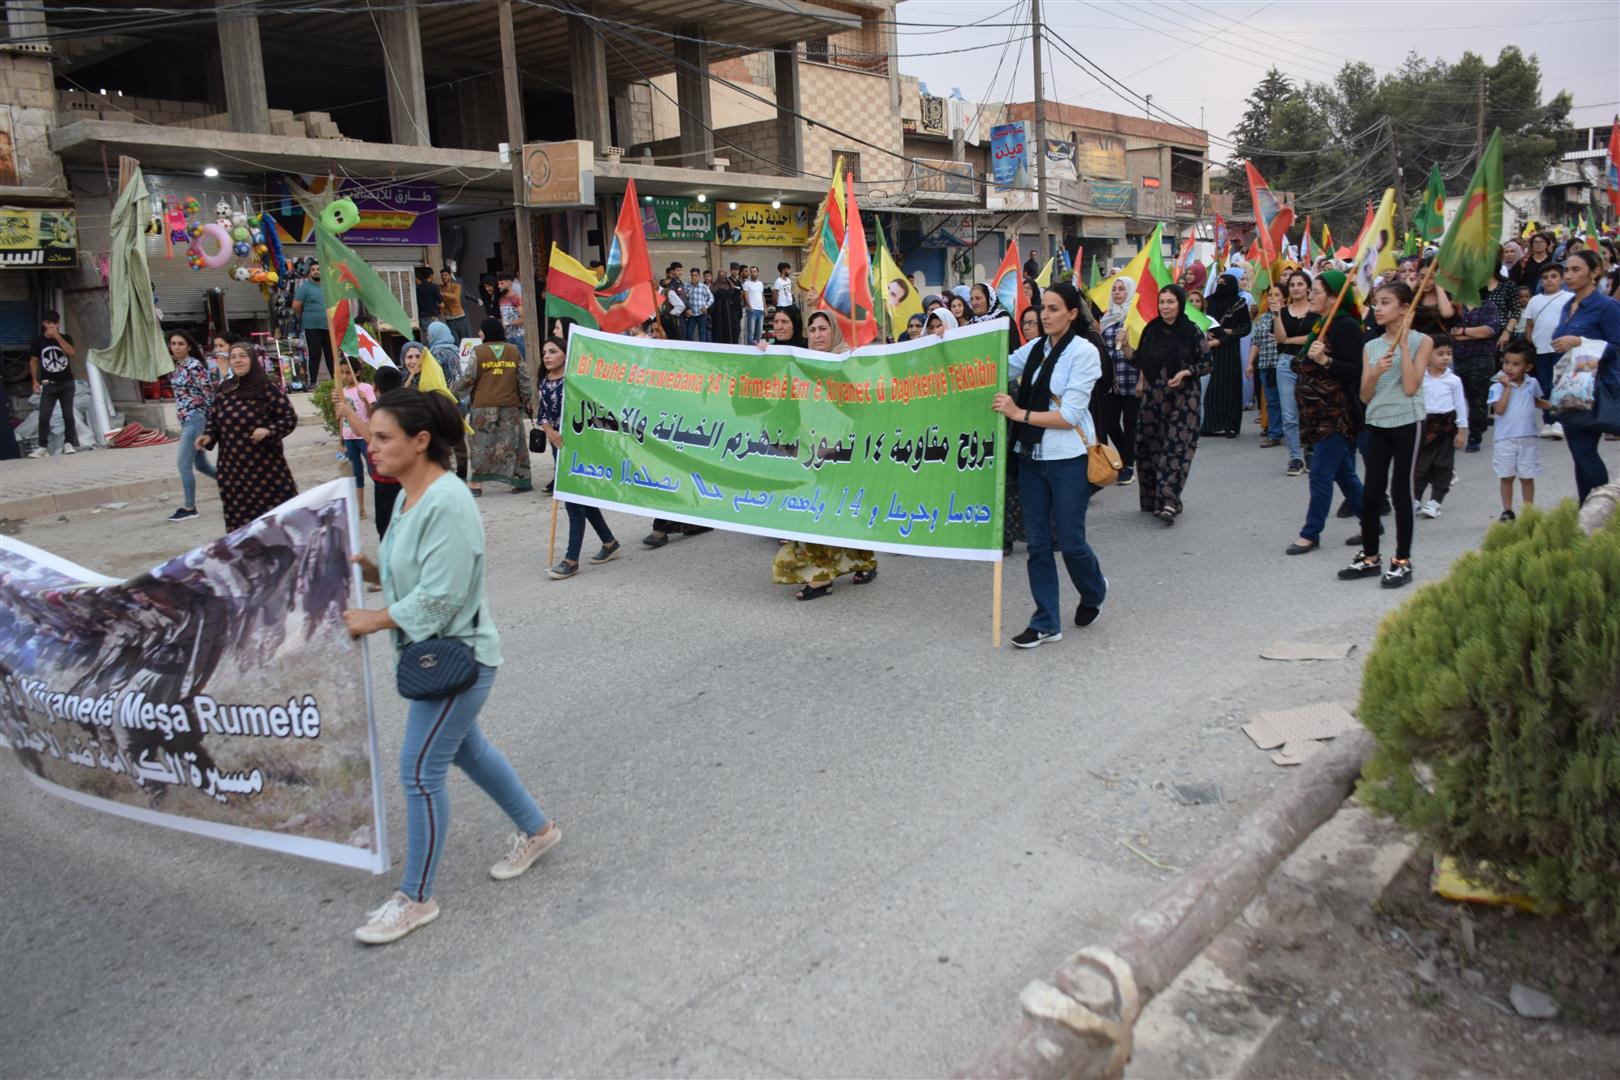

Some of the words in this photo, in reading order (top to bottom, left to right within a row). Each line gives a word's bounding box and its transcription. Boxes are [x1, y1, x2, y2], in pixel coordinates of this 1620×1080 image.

[395, 188, 432, 205] طارق
[667, 207, 711, 233] بهاء
[740, 209, 764, 230] دليار
[765, 209, 792, 231] احذية
[628, 364, 703, 393] Berxwedana
[572, 400, 648, 445] والاحتلال
[652, 411, 726, 452] الخيانة
[721, 425, 800, 462] سنهزم
[802, 430, 856, 470] تموز
[864, 432, 886, 464] ١٤
[889, 425, 950, 472] مقاومة
[957, 428, 995, 471] بروح
[835, 487, 866, 517] 14
[120, 691, 192, 740] Meşa
[194, 694, 321, 739] Rumetê
[89, 739, 187, 786] الكرامة
[189, 752, 264, 804] مسيرة
